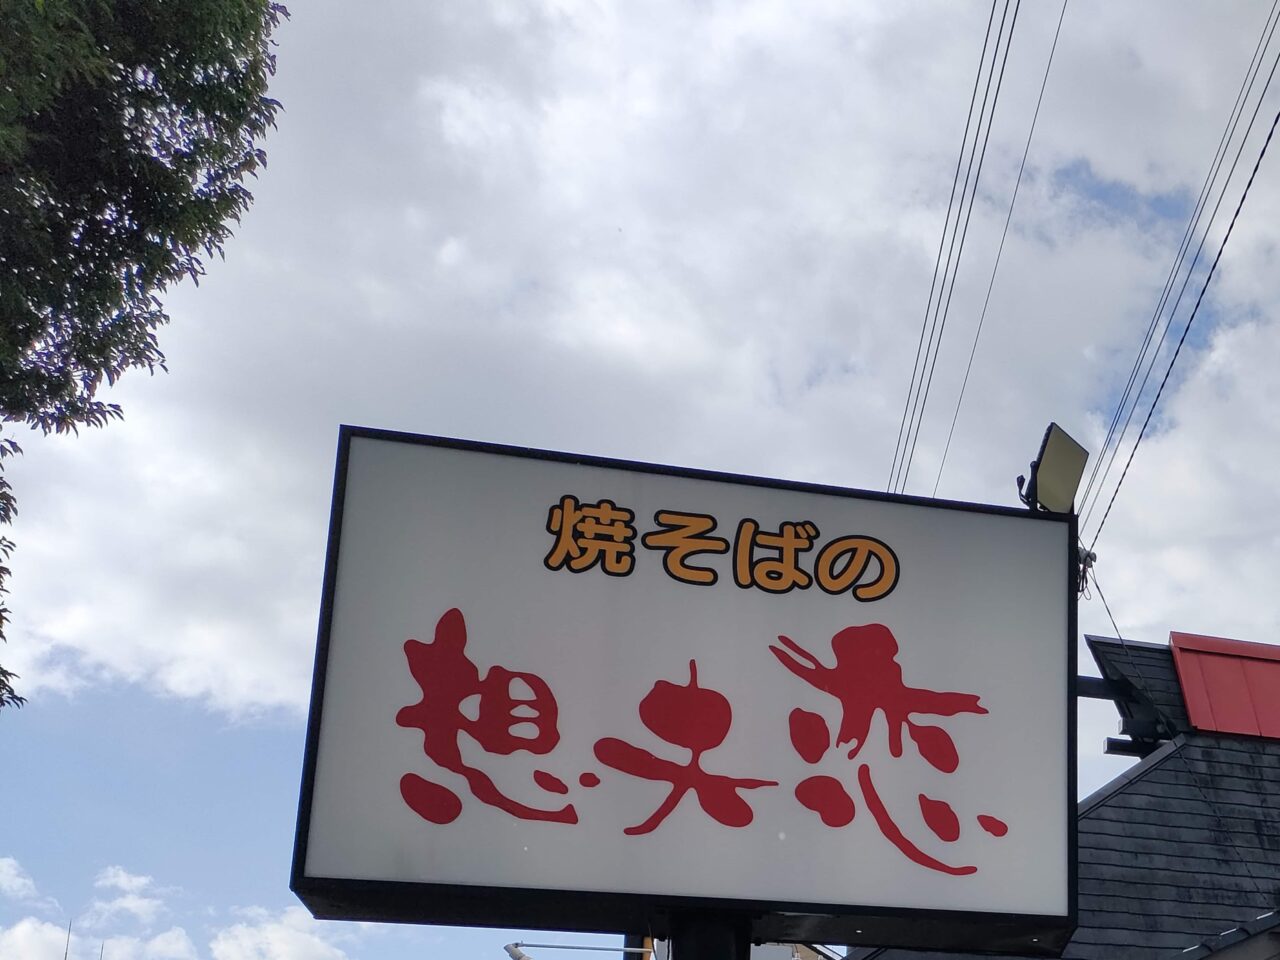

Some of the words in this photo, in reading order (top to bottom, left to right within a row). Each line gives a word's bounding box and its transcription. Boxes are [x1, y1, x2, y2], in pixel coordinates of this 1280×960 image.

[545, 494, 900, 603] 焼そばの
[396, 607, 1008, 876] 想夫恋
